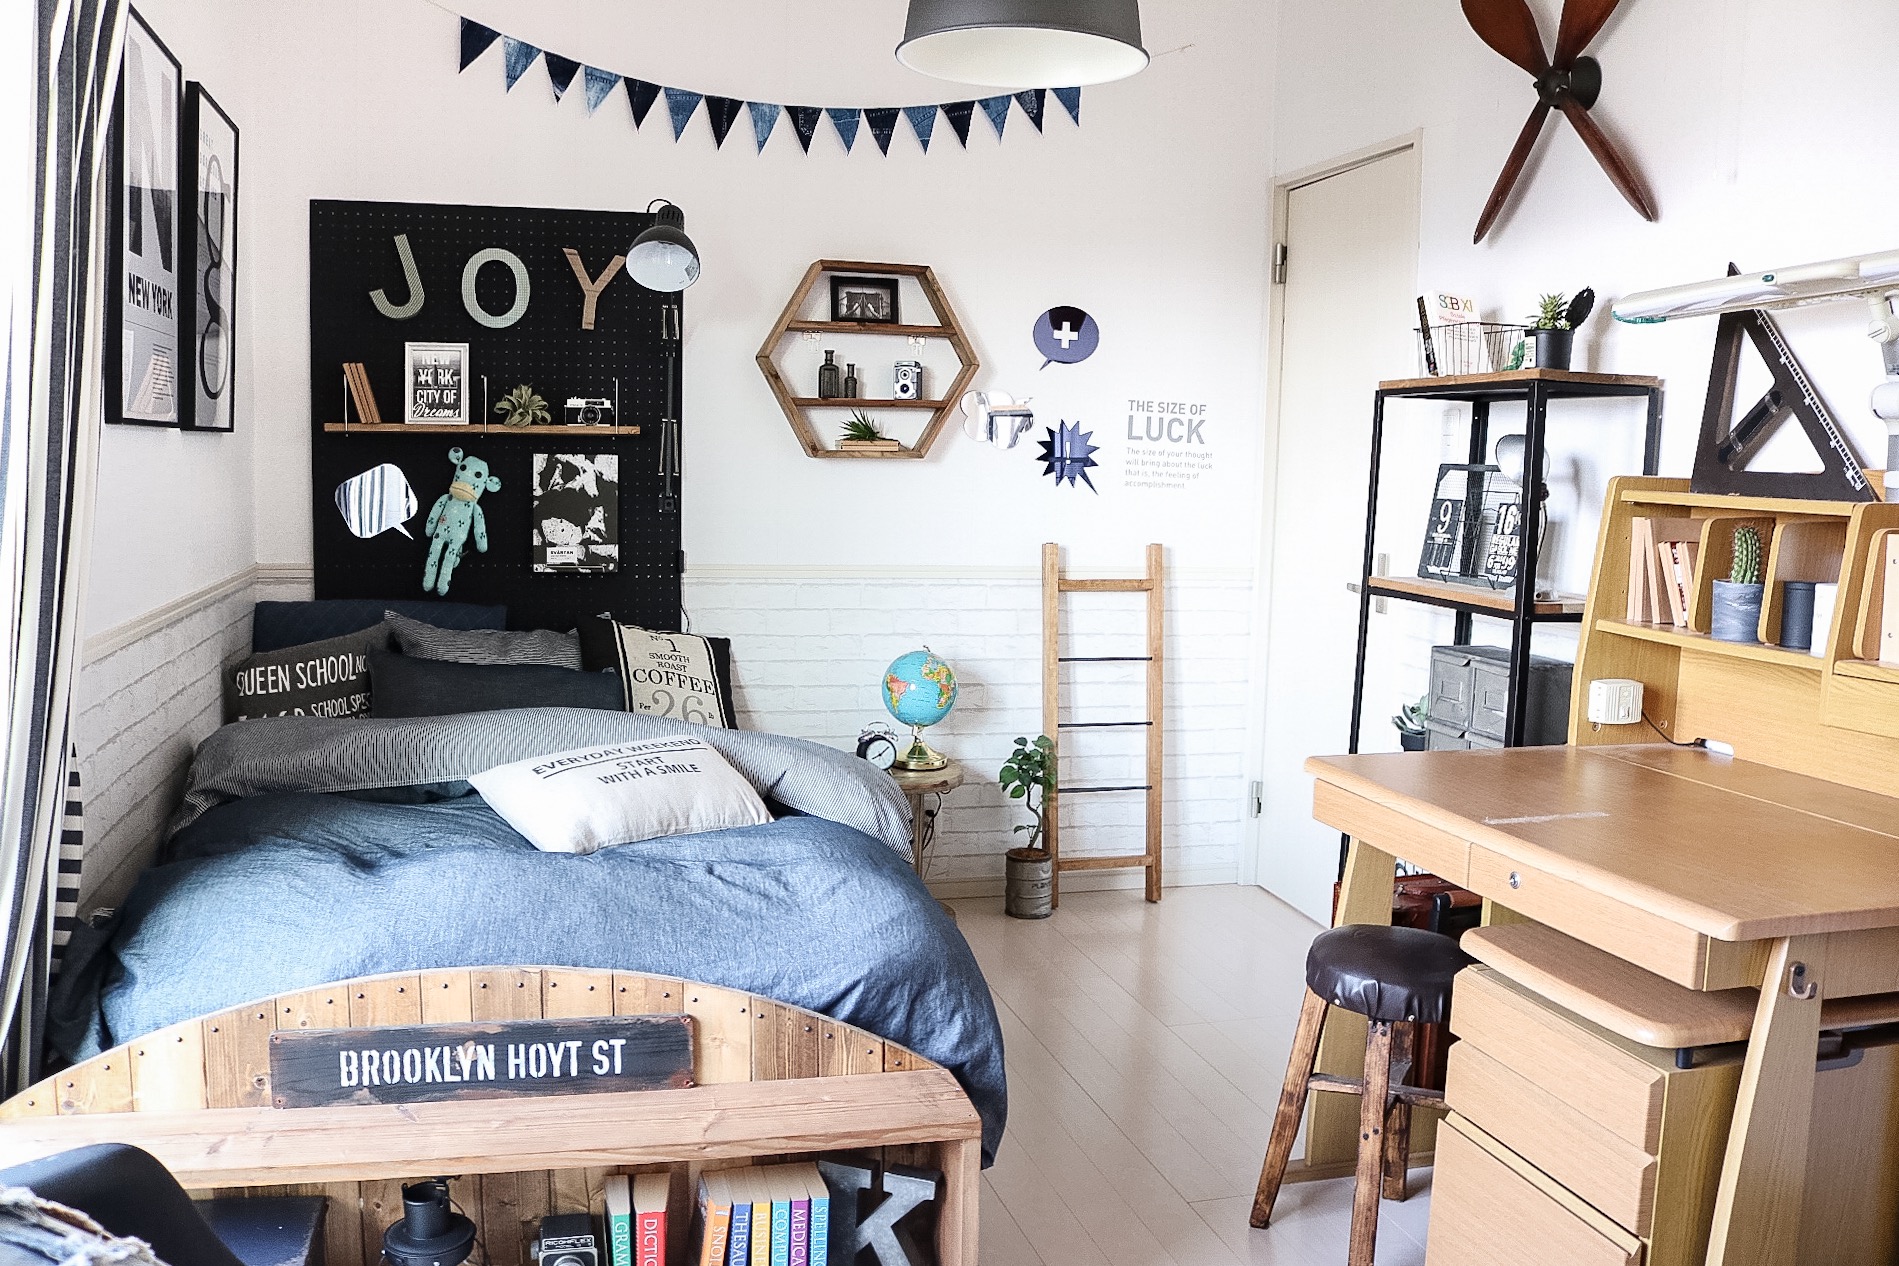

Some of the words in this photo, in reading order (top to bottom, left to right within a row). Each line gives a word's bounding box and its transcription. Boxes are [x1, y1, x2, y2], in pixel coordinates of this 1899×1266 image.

[368, 233, 627, 331] JOY
[129, 271, 151, 311] NEW
[151, 283, 173, 320] YORK
[421, 354, 450, 366] NEW
[416, 389, 441, 404] CITY
[443, 389, 458, 404] OF
[412, 401, 460, 418] Dreams
[1128, 400, 1155, 413] THE
[1157, 402, 1187, 415] SIZE
[1189, 404, 1207, 416] OF
[1127, 414, 1207, 445] LUCK
[1125, 458, 1140, 466] will
[1141, 459, 1161, 469] bring
[1162, 459, 1183, 469] about
[1184, 460, 1196, 470] the
[1197, 461, 1213, 470] luck
[1126, 446, 1141, 456] The
[1142, 449, 1157, 457] size
[1158, 448, 1166, 457] of
[1167, 450, 1184, 459] your
[1185, 450, 1213, 461] thought
[1125, 468, 1140, 477] that
[1152, 469, 1164, 478] the
[1165, 470, 1191, 481] feeling
[1192, 471, 1200, 480] of
[1436, 500, 1453, 534] 9
[1496, 503, 1518, 535] 16
[664, 638, 681, 653] 1
[648, 652, 691, 664] SMOOTH
[656, 661, 688, 673] ROAST
[236, 664, 291, 697] QUEEN
[295, 653, 357, 690] SCHOOL
[632, 668, 716, 696] COFFEE
[311, 696, 352, 719] SCHOOL
[639, 702, 652, 711] Per
[651, 689, 709, 725] 26
[532, 748, 623, 775] EVERYDAY
[626, 737, 701, 753] WEEKEND
[616, 755, 665, 771] START
[598, 769, 643, 785] WITH
[643, 767, 657, 778] A
[660, 763, 702, 776] SMILE
[339, 1043, 496, 1088] BROOKLYN
[507, 1040, 583, 1080] HOYT
[591, 1038, 627, 1076] ST
